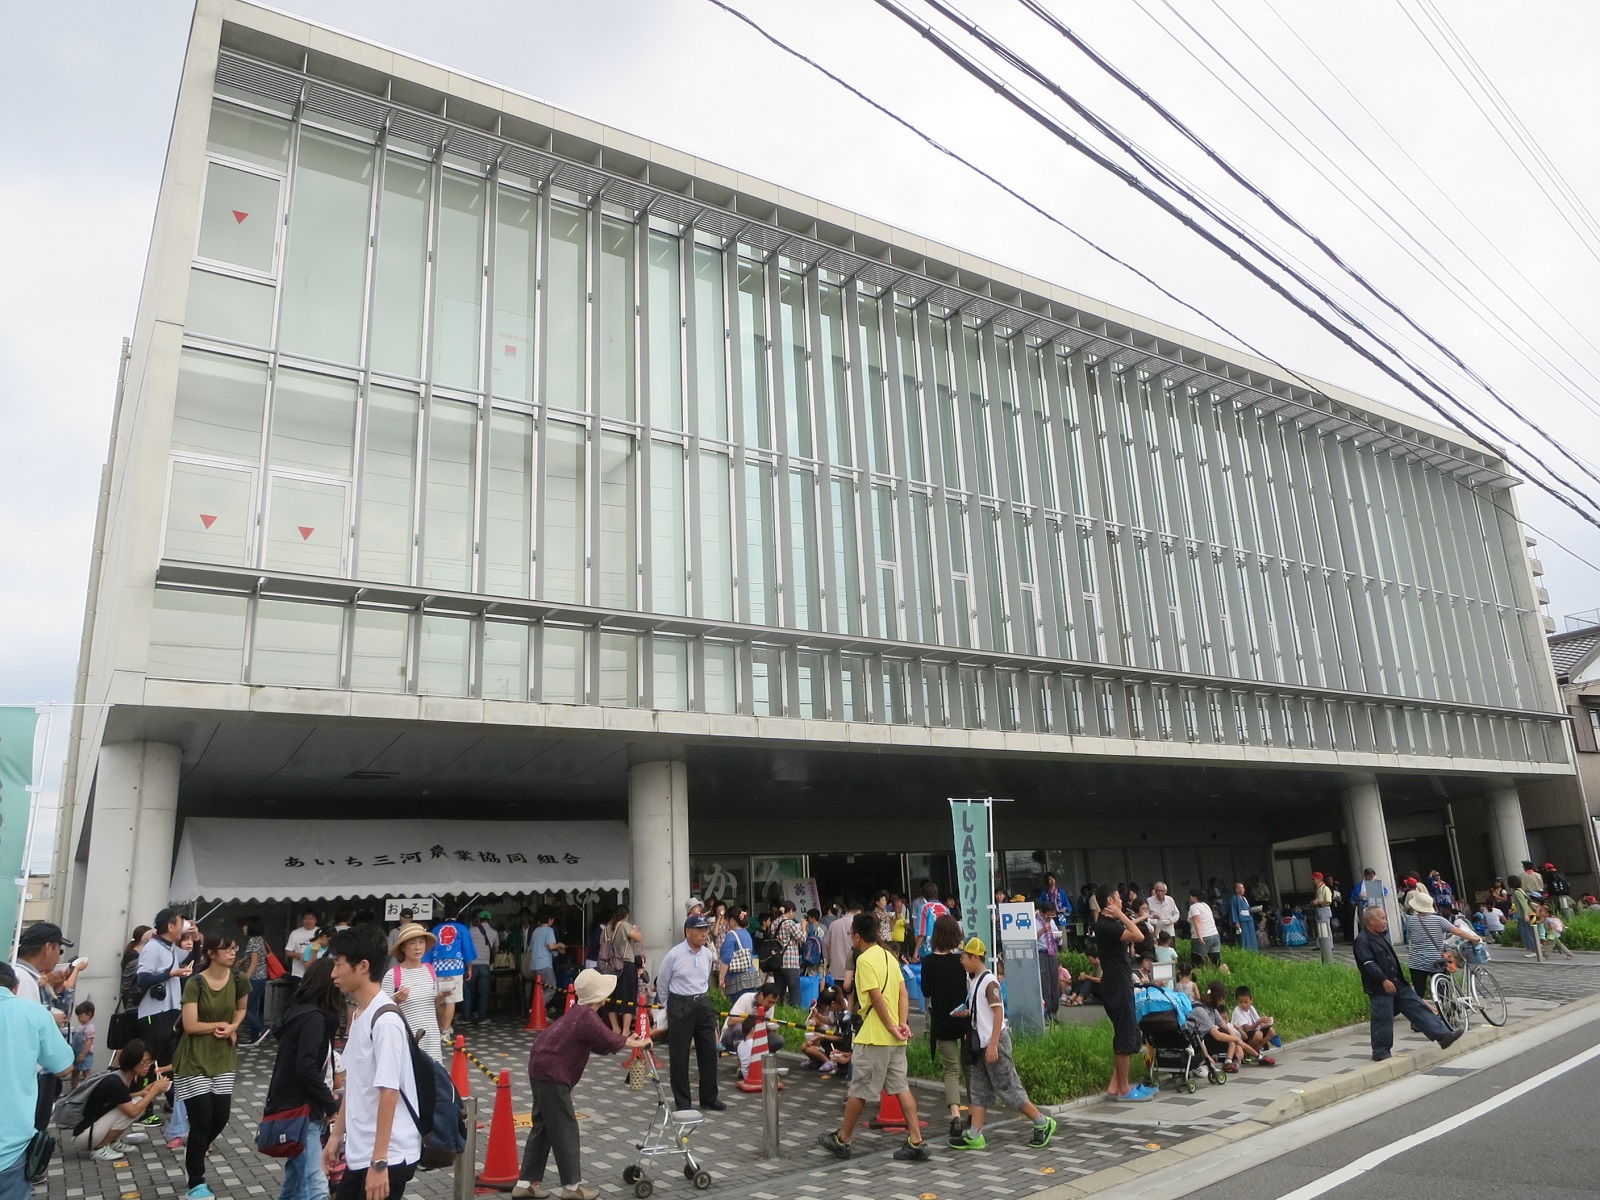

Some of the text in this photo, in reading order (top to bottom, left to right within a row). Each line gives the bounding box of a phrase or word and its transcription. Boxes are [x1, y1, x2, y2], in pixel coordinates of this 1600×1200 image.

[285, 844, 581, 868] あいち三河農業協同組合
[1002, 914, 1014, 930] P
